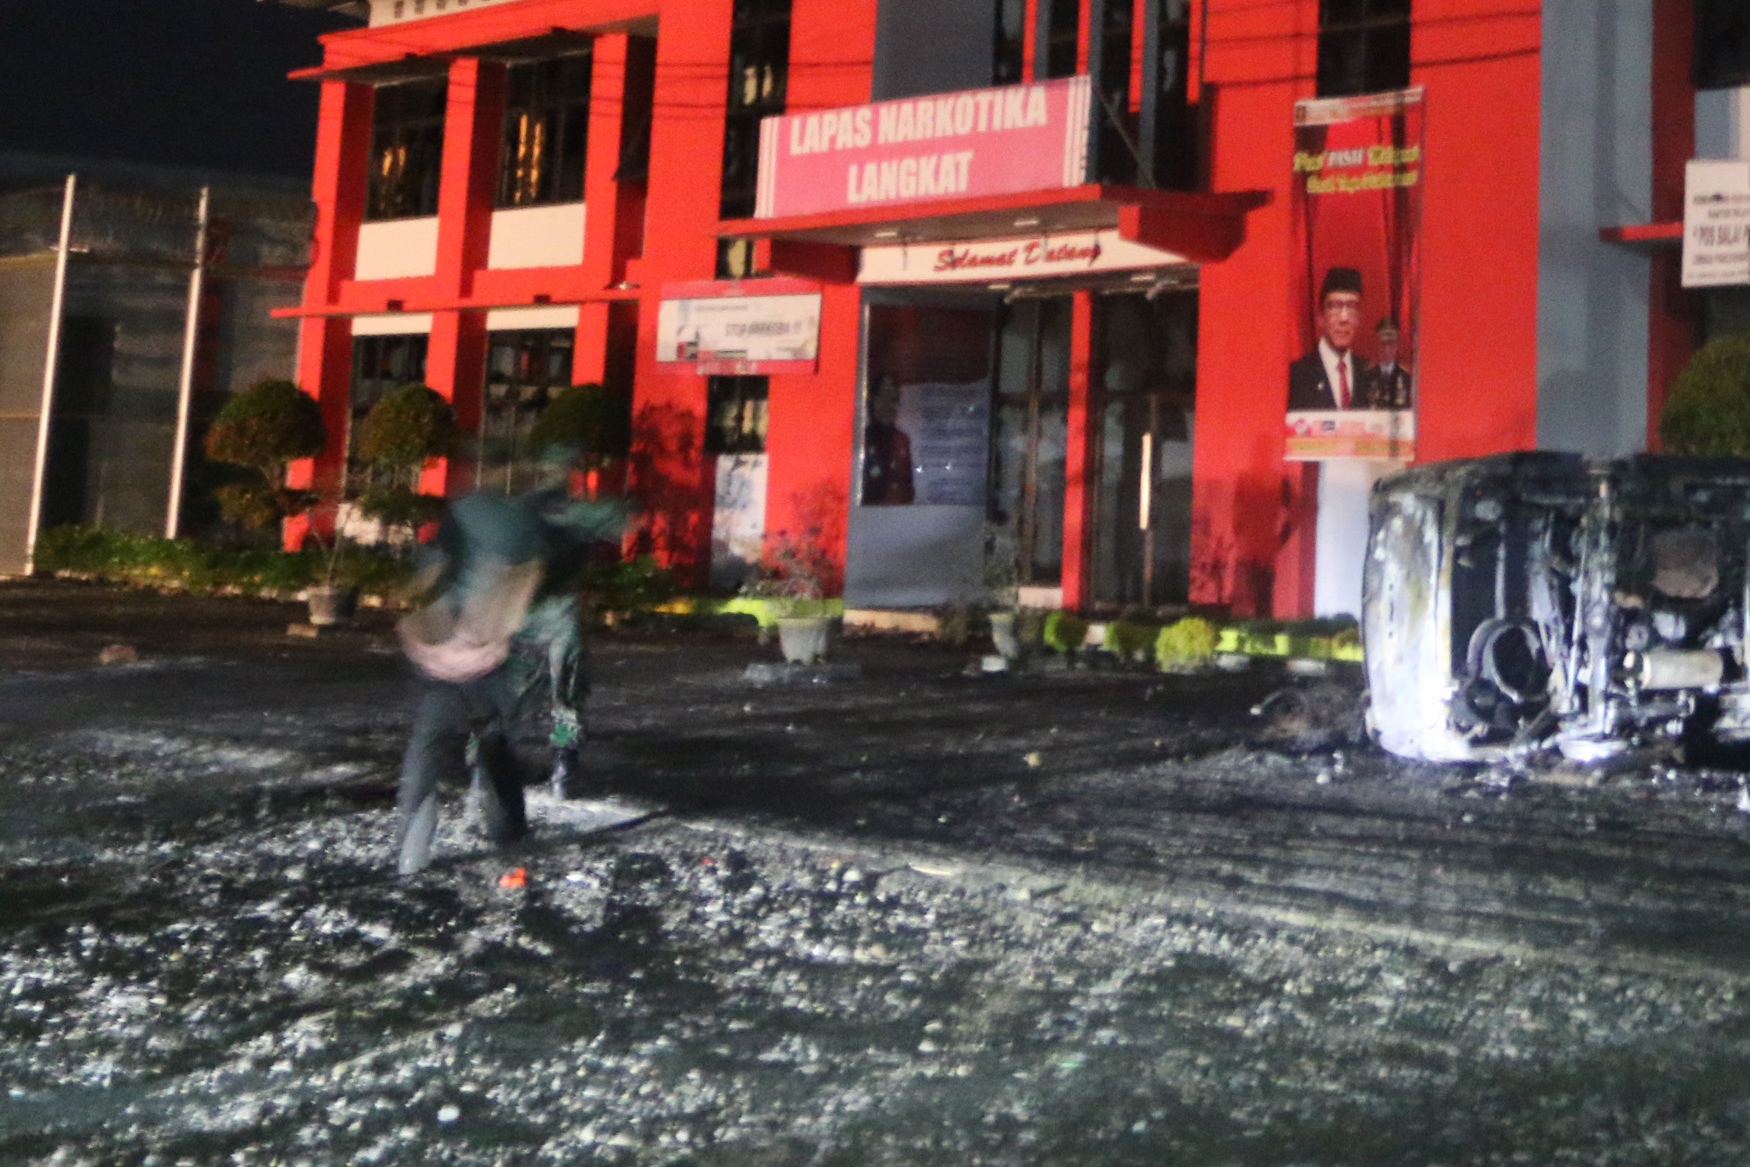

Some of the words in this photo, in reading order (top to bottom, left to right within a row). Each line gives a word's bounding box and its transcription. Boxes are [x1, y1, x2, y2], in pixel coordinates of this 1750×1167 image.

[789, 107, 873, 156] LAPAS
[878, 85, 1048, 145] NARKOTIKA
[847, 150, 974, 204] LANGKAT
